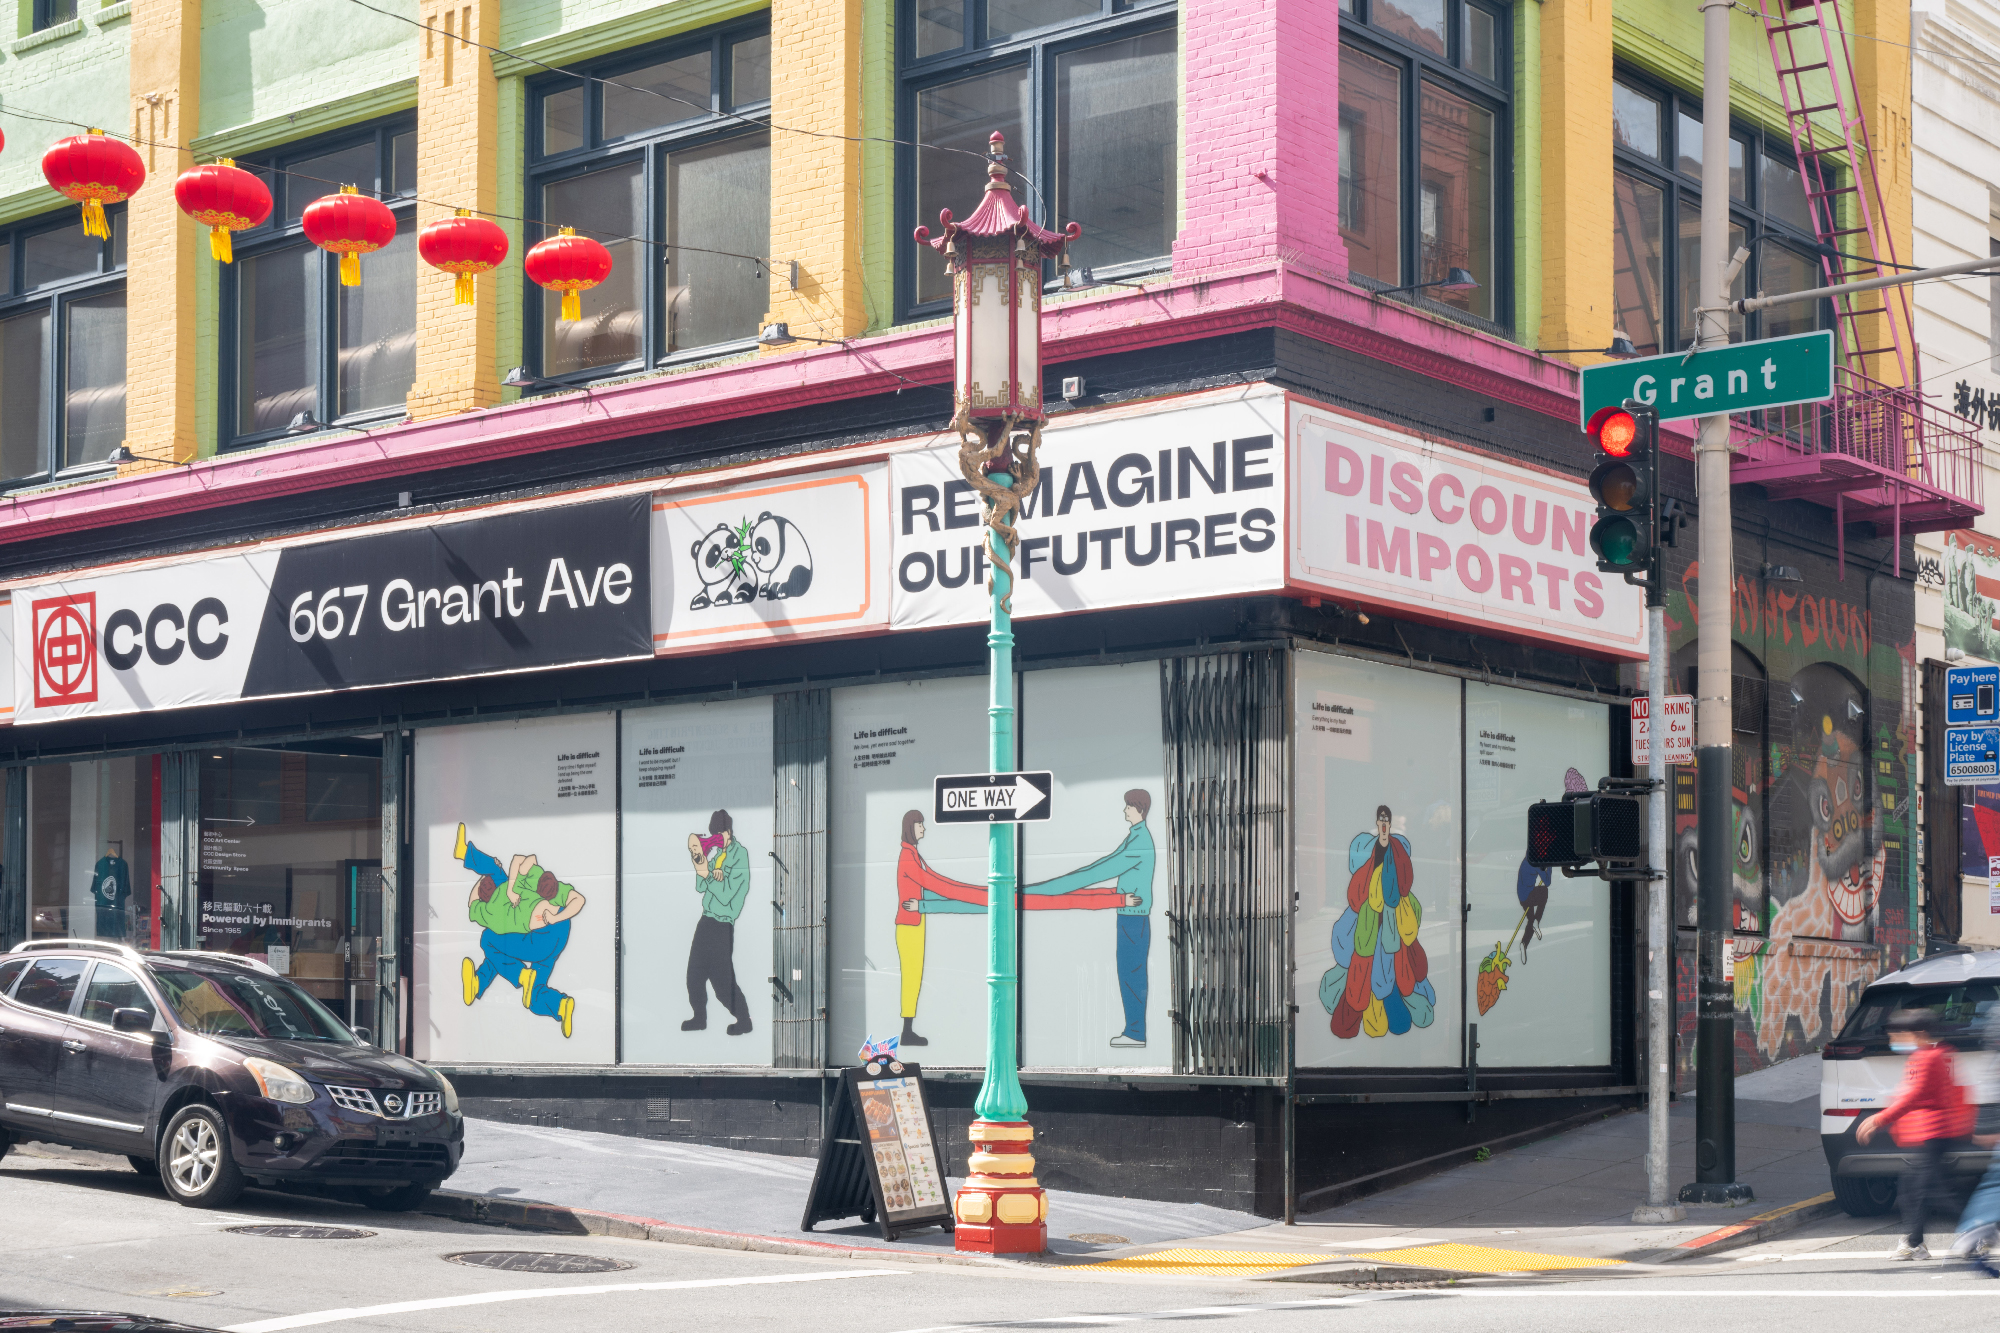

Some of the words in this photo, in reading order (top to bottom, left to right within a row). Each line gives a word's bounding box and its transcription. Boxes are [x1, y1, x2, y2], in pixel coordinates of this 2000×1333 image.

[1632, 357, 1777, 406] Grant
[901, 434, 1274, 535] REMAGINE
[1325, 441, 1597, 557] DISCOUN
[1021, 508, 1276, 580] FUTURES
[1345, 514, 1605, 619] IMPORTS
[289, 584, 369, 643] 667
[380, 567, 524, 632] Grant
[538, 557, 633, 613] Ave
[1682, 560, 1872, 659] CNATOWN
[103, 596, 230, 671] CCC
[1950, 674, 1970, 686] Pay
[1972, 672, 1997, 683] here
[1312, 703, 1324, 711] Life
[1331, 705, 1354, 715] difficult
[1633, 700, 1649, 717] NO
[1664, 702, 1690, 715] RKING
[854, 731, 868, 739] Life
[878, 727, 907, 737] difficult
[1480, 730, 1490, 738] Life
[1496, 733, 1515, 742] difficult
[1950, 732, 1968, 743] Pay
[1971, 730, 1983, 743] by
[1678, 737, 1691, 748] SUN
[1950, 742, 1987, 752] License
[576, 751, 600, 759] difficult
[660, 746, 685, 754] difficult
[1950, 753, 1975, 762] Plate
[1951, 764, 1995, 775] 65008003
[947, 790, 977, 808] ONE
[984, 789, 1016, 807] WAY
[202, 914, 250, 924] Powered
[253, 915, 267, 927] by
[269, 917, 332, 928] Immigrants
[1885, 908, 1904, 926] SAN
[202, 926, 223, 934] Since
[877, 1043, 889, 1053] Ice
